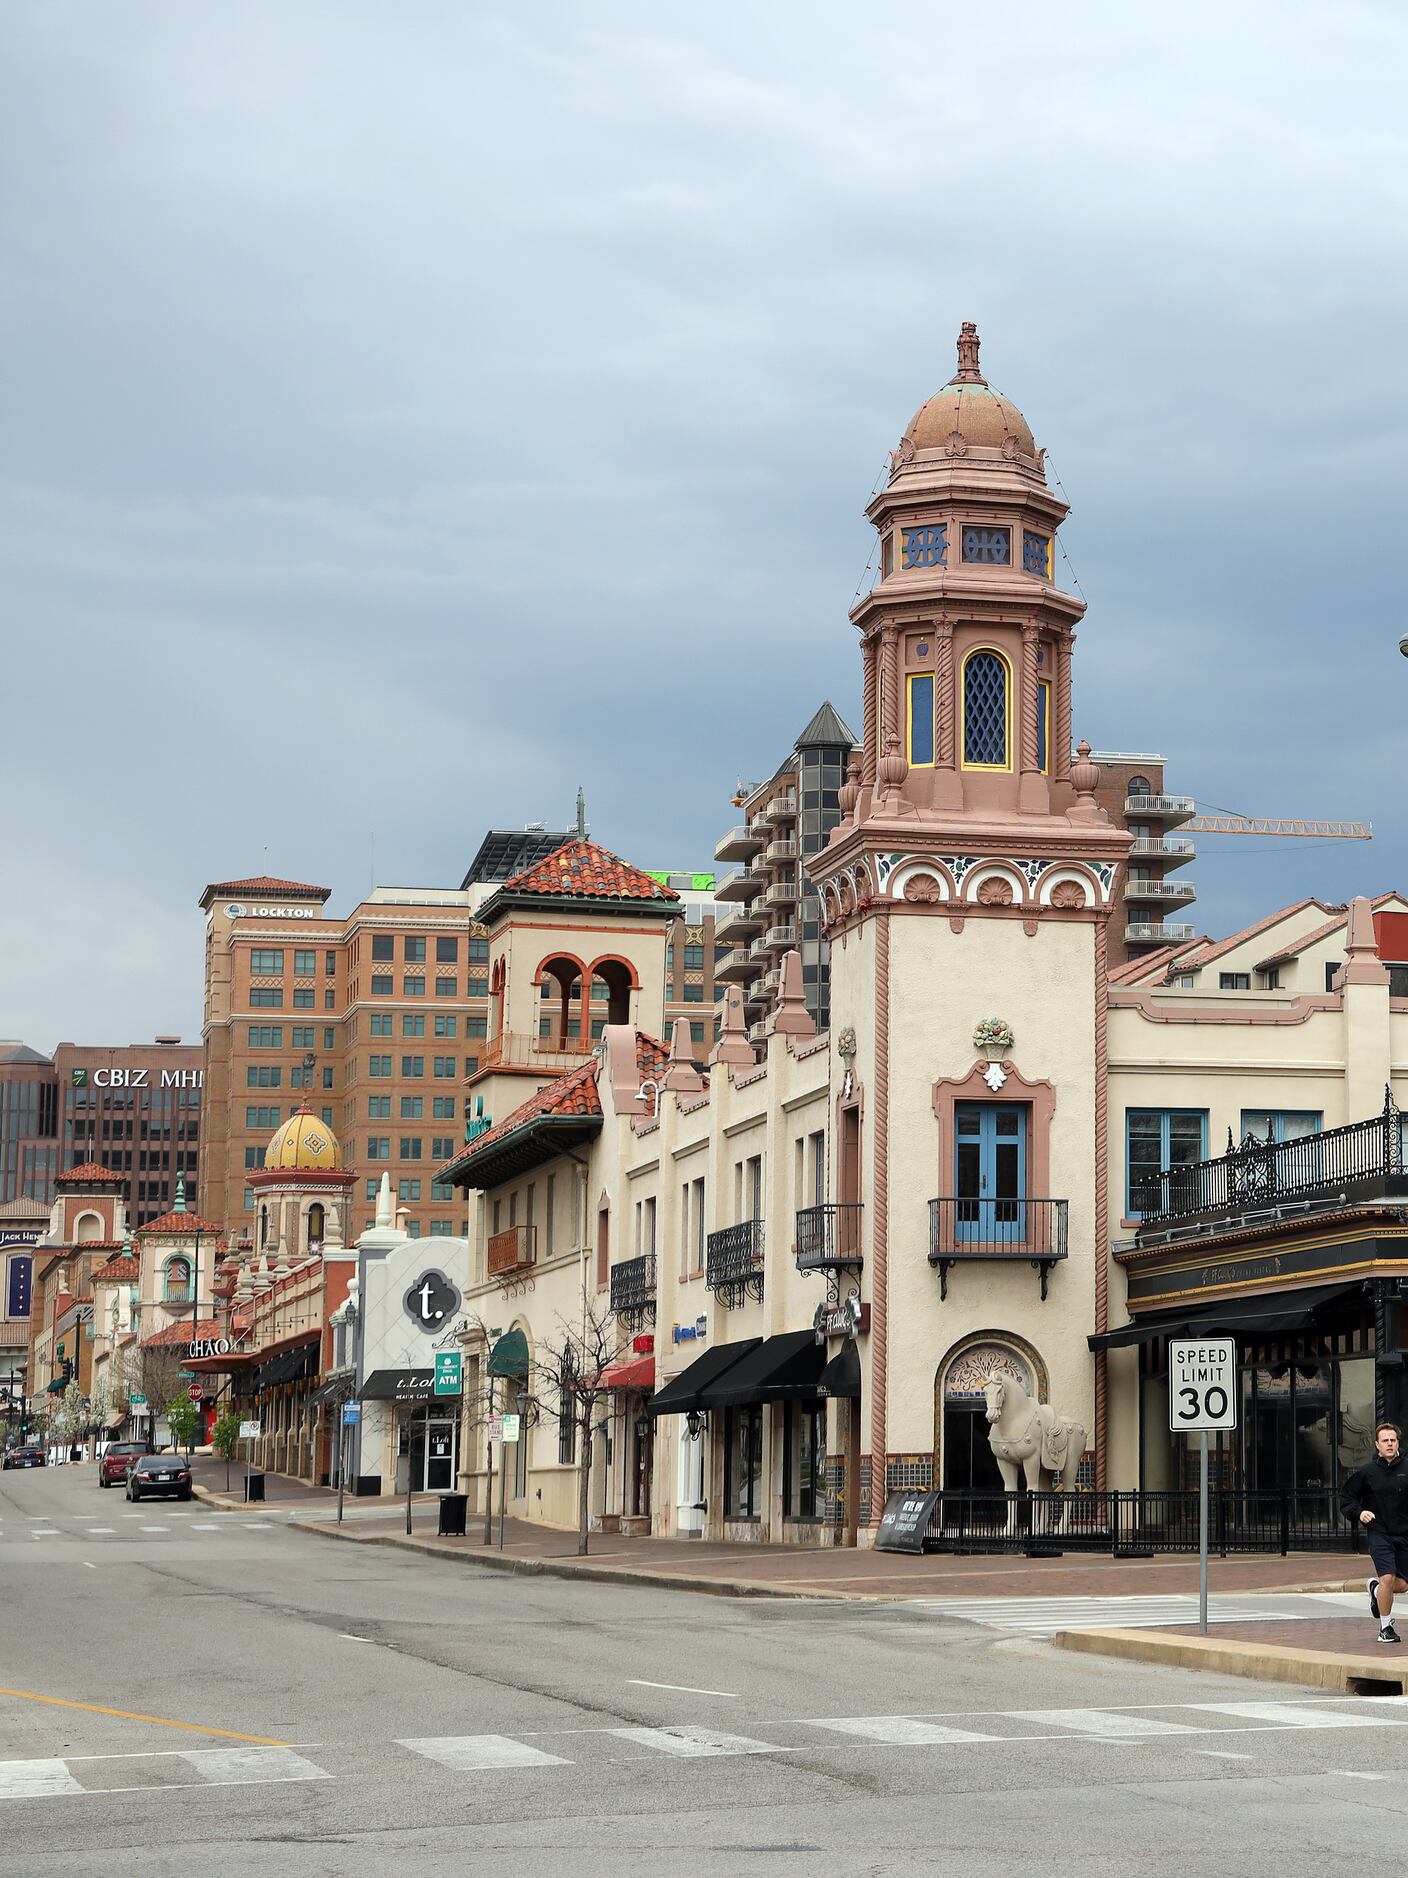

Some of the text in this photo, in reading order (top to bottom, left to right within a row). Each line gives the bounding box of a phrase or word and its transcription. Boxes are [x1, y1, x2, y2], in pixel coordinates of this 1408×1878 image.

[252, 907, 314, 918] LOCKTON
[93, 1068, 205, 1088] CBIZ MH
[1177, 1349, 1227, 1364] SPEED
[438, 1375, 458, 1385] ATM
[1182, 1367, 1223, 1382] LIMIT
[189, 1389, 202, 1397] STOP
[1178, 1386, 1228, 1420] 30
